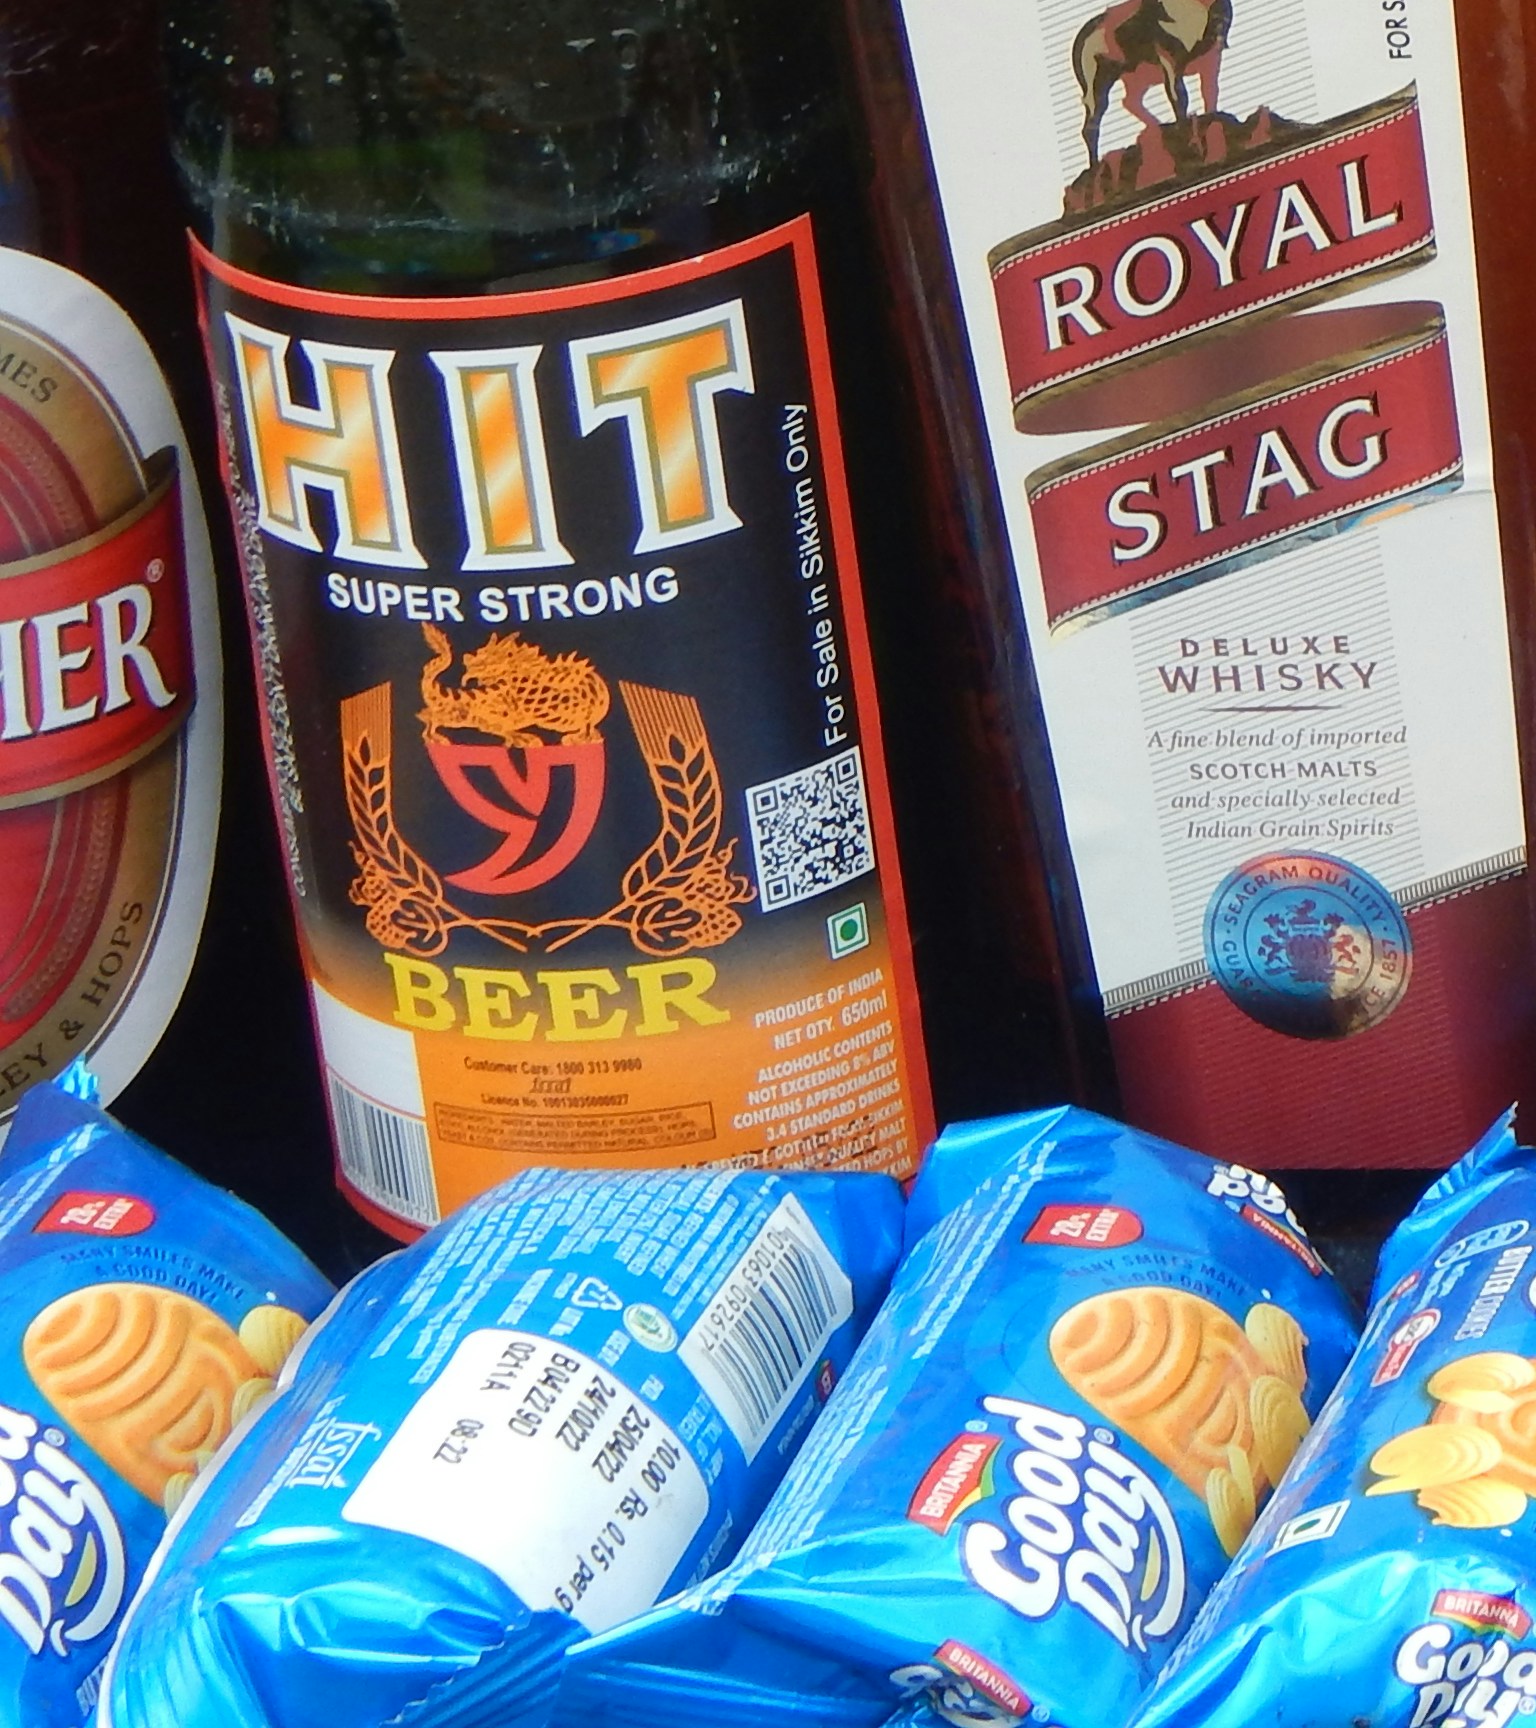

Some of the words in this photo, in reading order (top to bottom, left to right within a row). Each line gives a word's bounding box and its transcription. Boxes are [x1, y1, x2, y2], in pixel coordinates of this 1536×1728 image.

[1385, 17, 1412, 60] FOR
[1036, 153, 1404, 355] ROYAL
[223, 298, 755, 571] HIT
[781, 403, 809, 473] Only
[1105, 389, 1392, 566] STAG
[793, 477, 824, 580] Sikkim
[327, 572, 464, 623] SUPER
[479, 567, 680, 622] STRONG
[807, 583, 830, 615] in
[812, 618, 840, 689] Sale
[1180, 634, 1351, 659] DELUXE
[1157, 660, 1379, 695] WHISKY
[824, 694, 848, 747] For
[1148, 730, 1164, 749] A
[1167, 728, 1209, 752] fine
[1214, 728, 1275, 749] blend
[1281, 727, 1306, 752] of
[1309, 725, 1408, 750] imported
[1189, 761, 1288, 781] SCOTCH
[1297, 759, 1378, 780] MALTS
[1171, 790, 1210, 810] and
[1216, 789, 1312, 814] specially
[1316, 787, 1401, 807] selected
[1186, 821, 1252, 840] Indian
[1259, 822, 1321, 840] Grain
[1326, 819, 1396, 841] Spirits
[1225, 864, 1300, 927] SEAGRAM
[1308, 866, 1386, 923] QUALITY
[384, 952, 731, 1043] BEER
[754, 993, 824, 1028] PRODUCE
[827, 986, 845, 1004] OF
[848, 968, 883, 995] INDIA
[773, 1030, 802, 1050] NET
[841, 989, 888, 1027] 650ml
[758, 1051, 831, 1084] ALCOHOLIC
[834, 1020, 892, 1057] CONTENTS
[555, 1375, 616, 1452] 24/10/22
[592, 1404, 650, 1483] 25/04/22
[641, 1438, 681, 1493] 10.00
[920, 1440, 986, 1518] BRITANNIA
[615, 1488, 648, 1520] Rs.
[964, 1396, 1088, 1618] Good
[590, 1521, 626, 1571] 0.15
[1066, 1444, 1186, 1650] Day
[554, 1587, 574, 1614] g
[570, 1554, 595, 1601] per
[949, 1650, 1020, 1712] BRITANNIA
